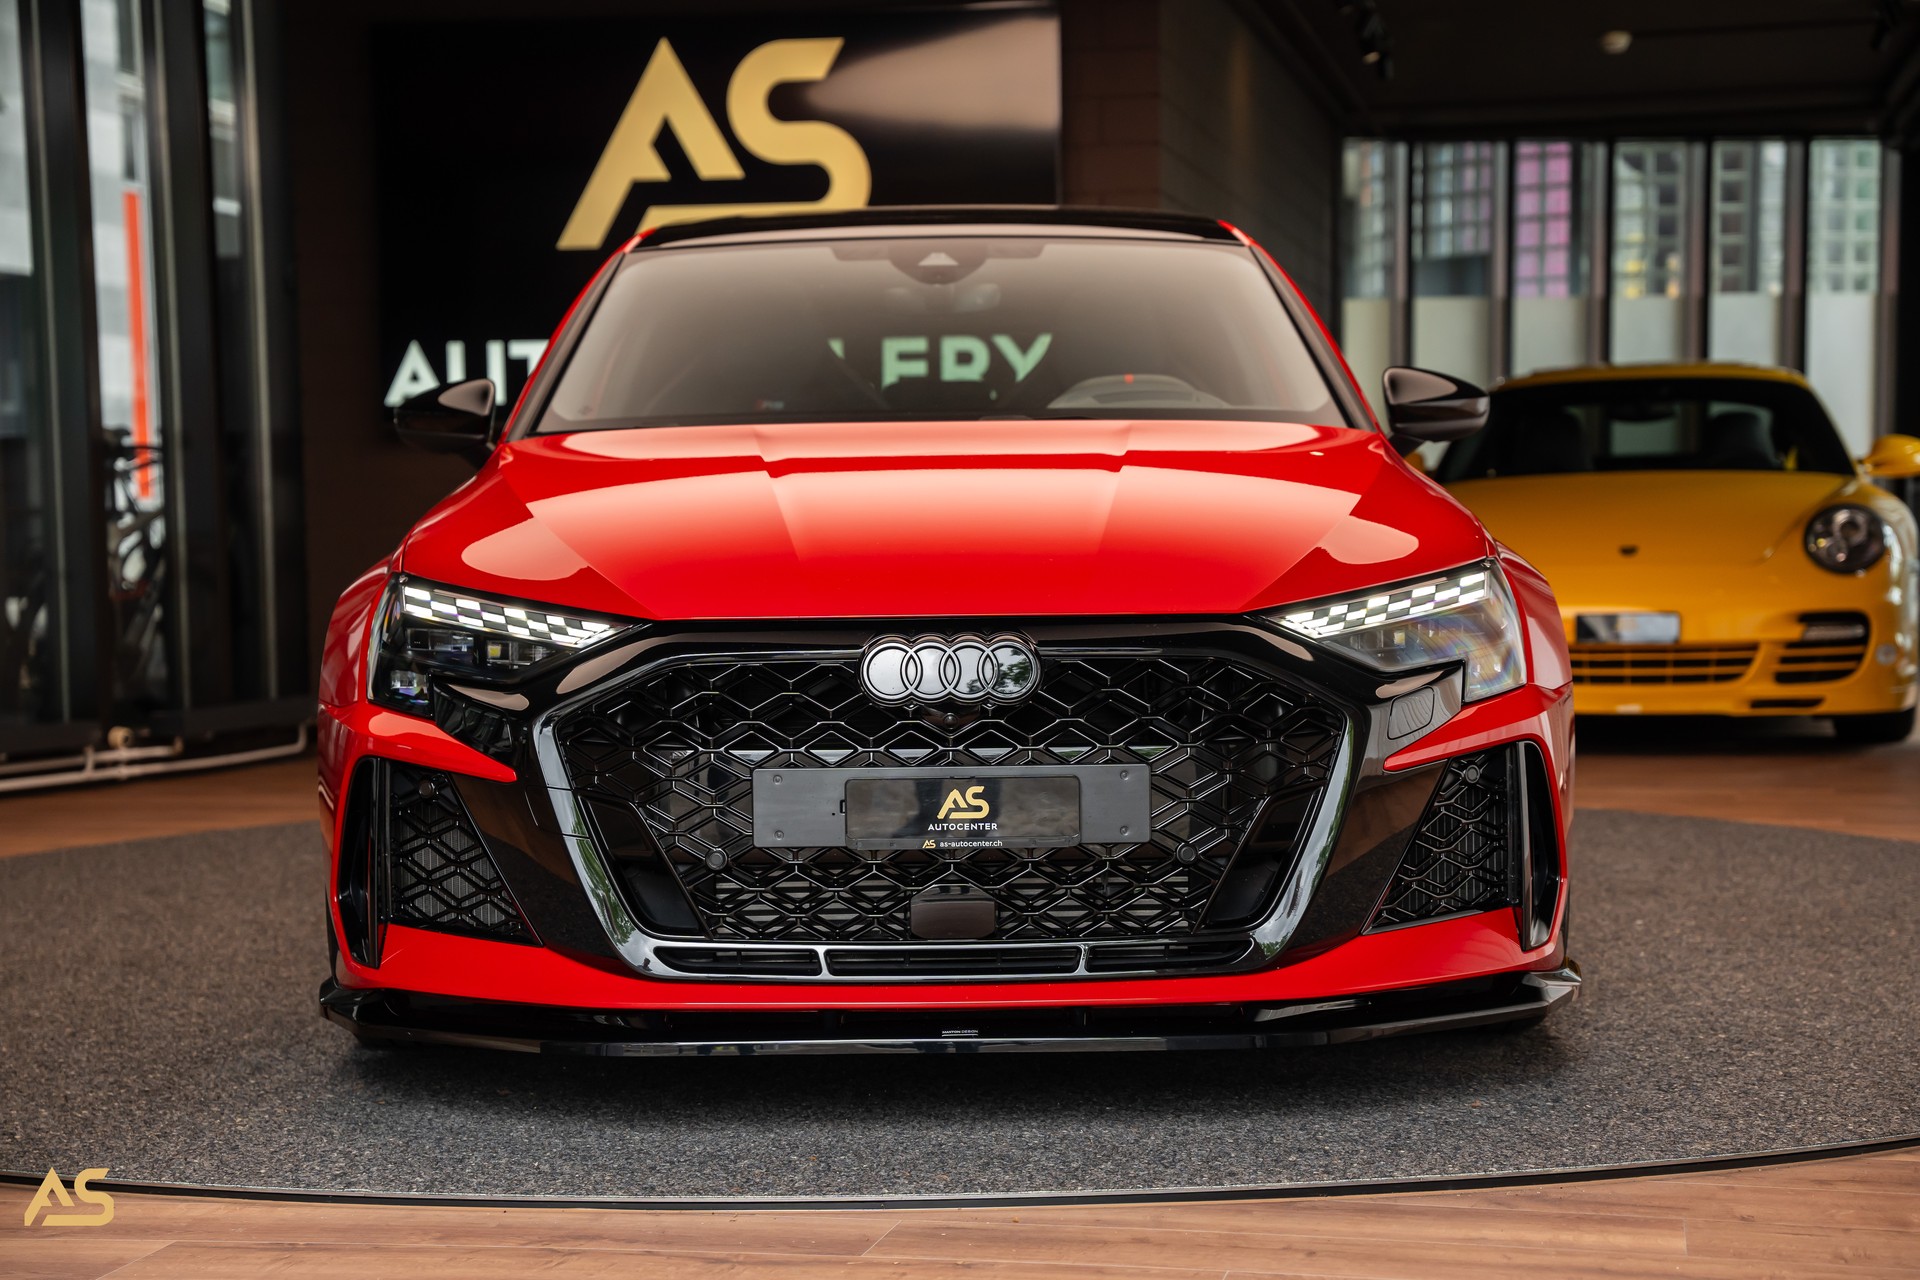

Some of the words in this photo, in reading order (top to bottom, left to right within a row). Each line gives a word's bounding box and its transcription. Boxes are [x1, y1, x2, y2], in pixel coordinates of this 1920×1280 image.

[557, 37, 871, 250] AS
[937, 786, 990, 819] AS
[928, 823, 998, 831] AUTOCENTER
[940, 840, 1003, 848] as-autocenter.ch
